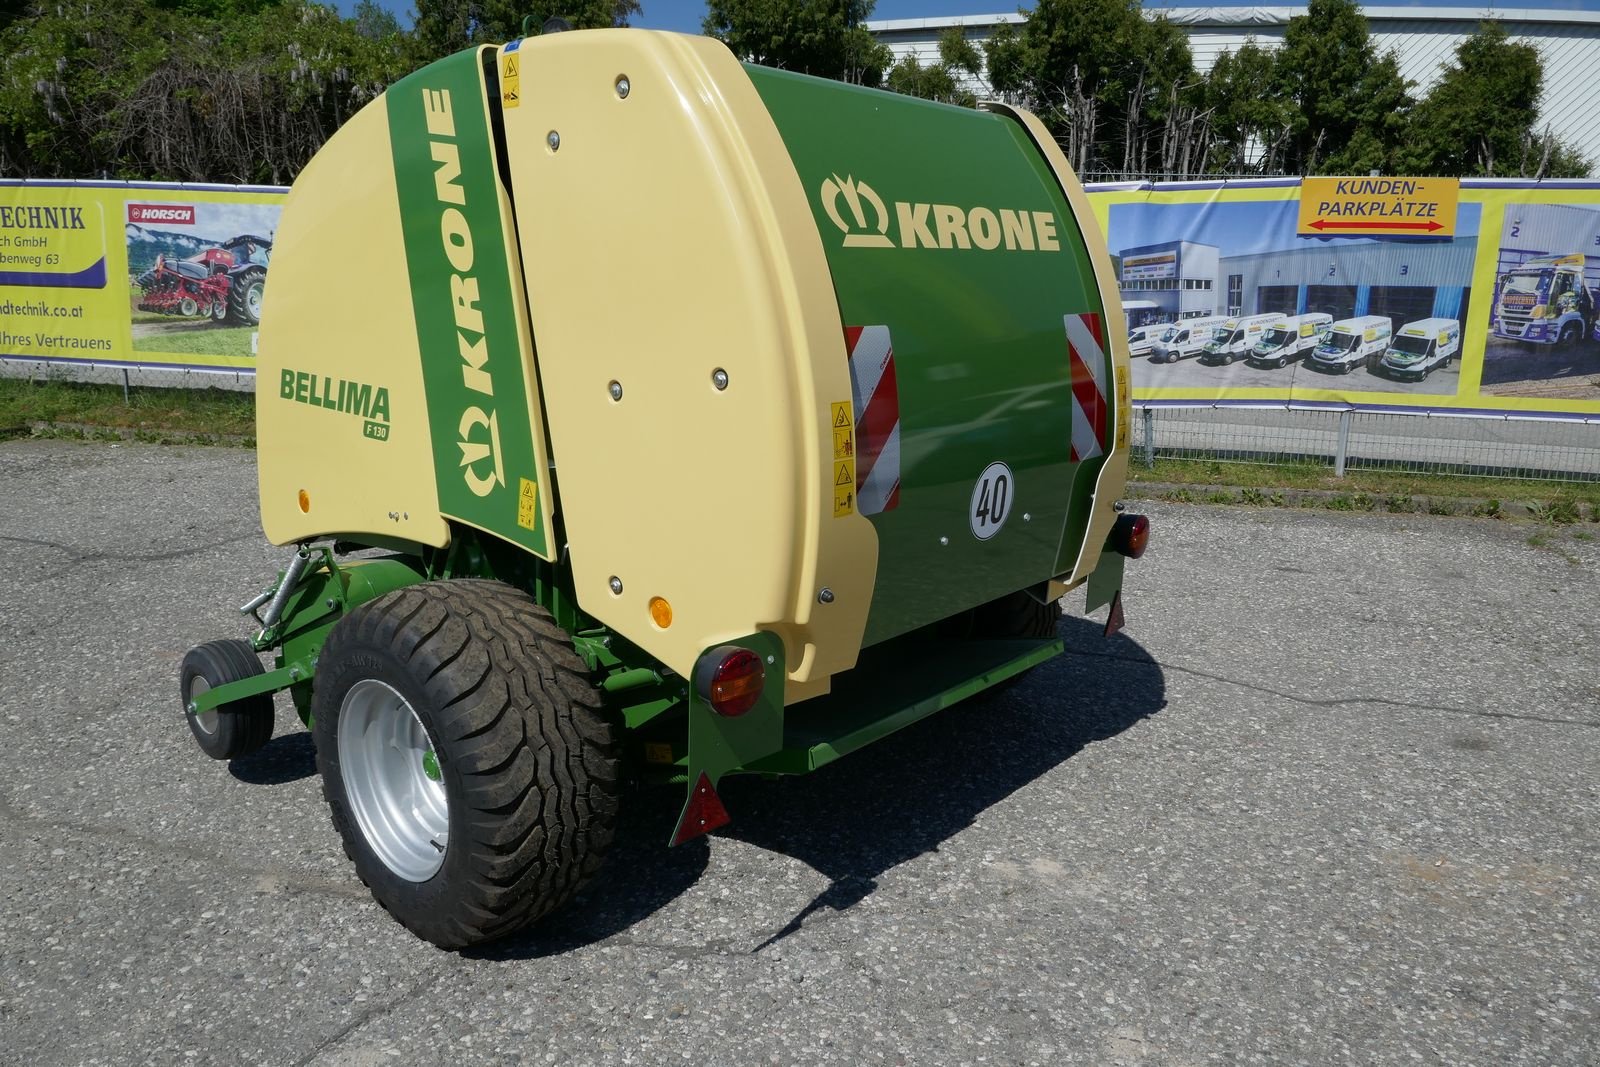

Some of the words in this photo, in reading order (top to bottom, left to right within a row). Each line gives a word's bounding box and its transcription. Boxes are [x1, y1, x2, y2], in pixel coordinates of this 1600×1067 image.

[1336, 180, 1425, 195] KUNDEN-
[141, 208, 191, 221] HORSCH
[1317, 197, 1439, 217] PARKPLÄTZE
[895, 201, 1061, 252] KRONE
[1511, 226, 1520, 238] 2
[14, 236, 47, 247] GmbH
[422, 88, 494, 397] KRONE
[45, 253, 60, 265] 63
[35, 333, 112, 350] Vertrauens
[280, 368, 391, 423] BELLIMA
[366, 424, 372, 435] F
[373, 426, 387, 438] 130
[976, 474, 1008, 527] 40
